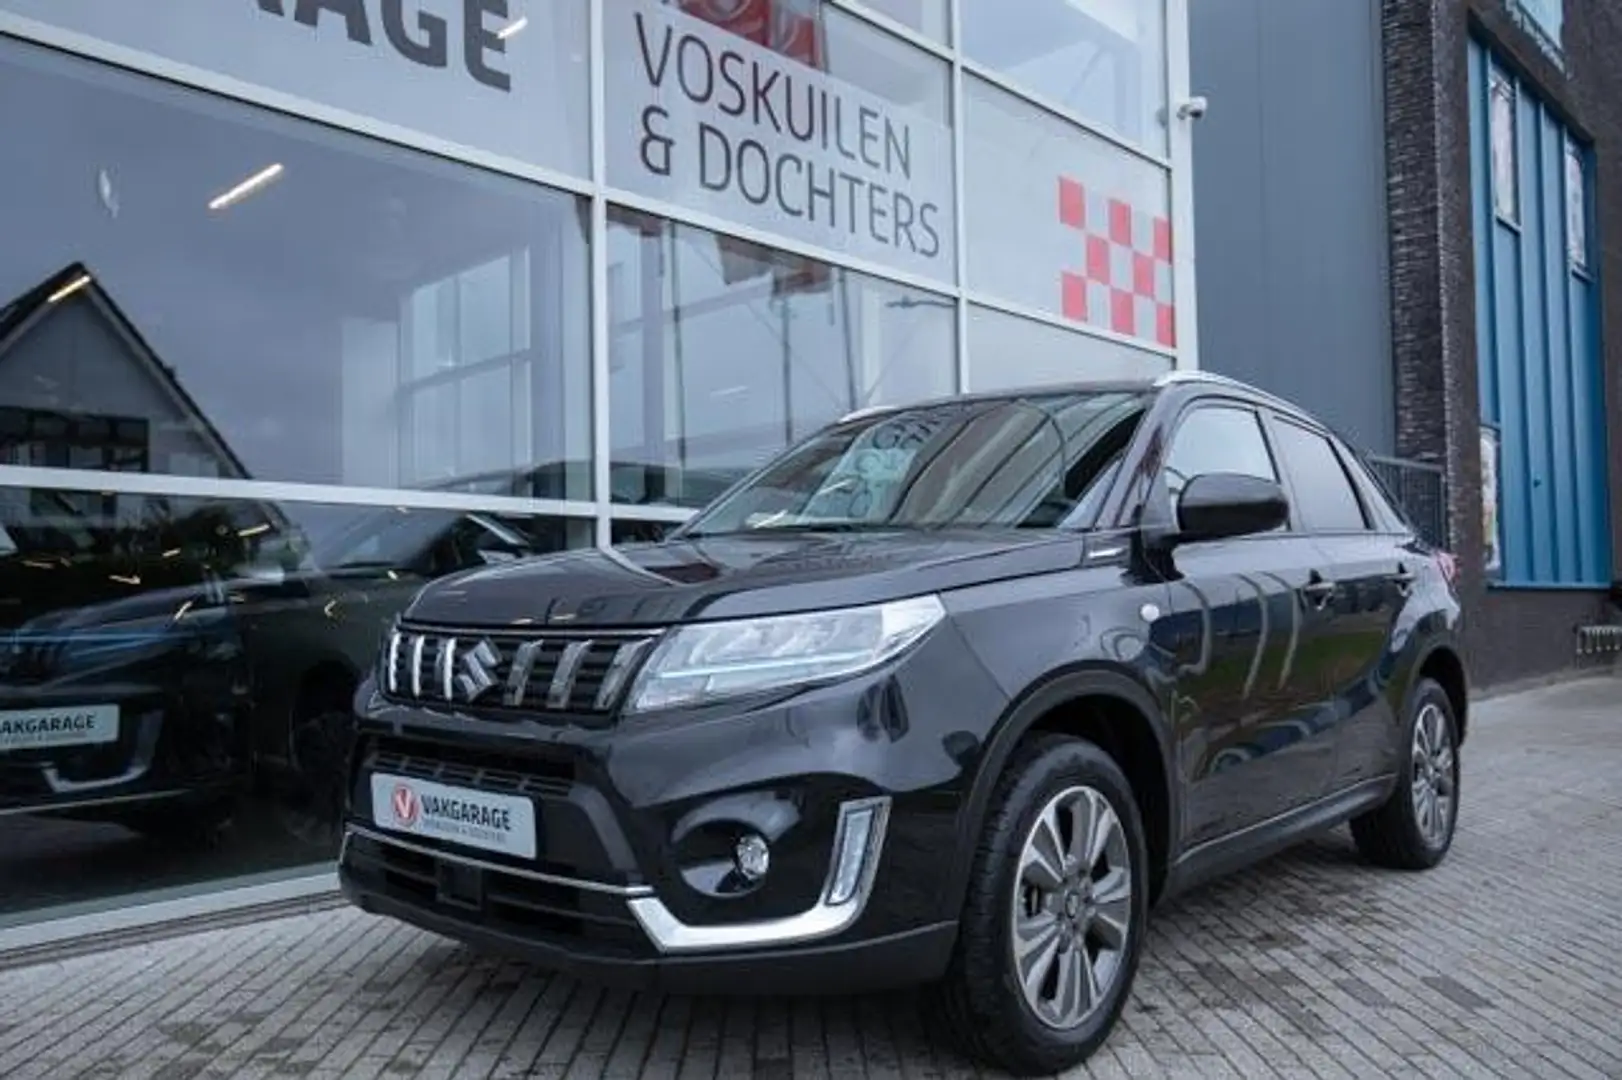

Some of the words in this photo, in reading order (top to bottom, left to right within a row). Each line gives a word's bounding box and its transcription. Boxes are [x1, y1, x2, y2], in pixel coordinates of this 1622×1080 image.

[258, 0, 511, 92] GE
[633, 13, 912, 180] VOSKUILEN
[639, 104, 675, 176] &
[698, 120, 940, 258] DOCHTERS
[0, 714, 96, 734] AKGARAGE
[421, 794, 510, 831] VAKGARAGE
